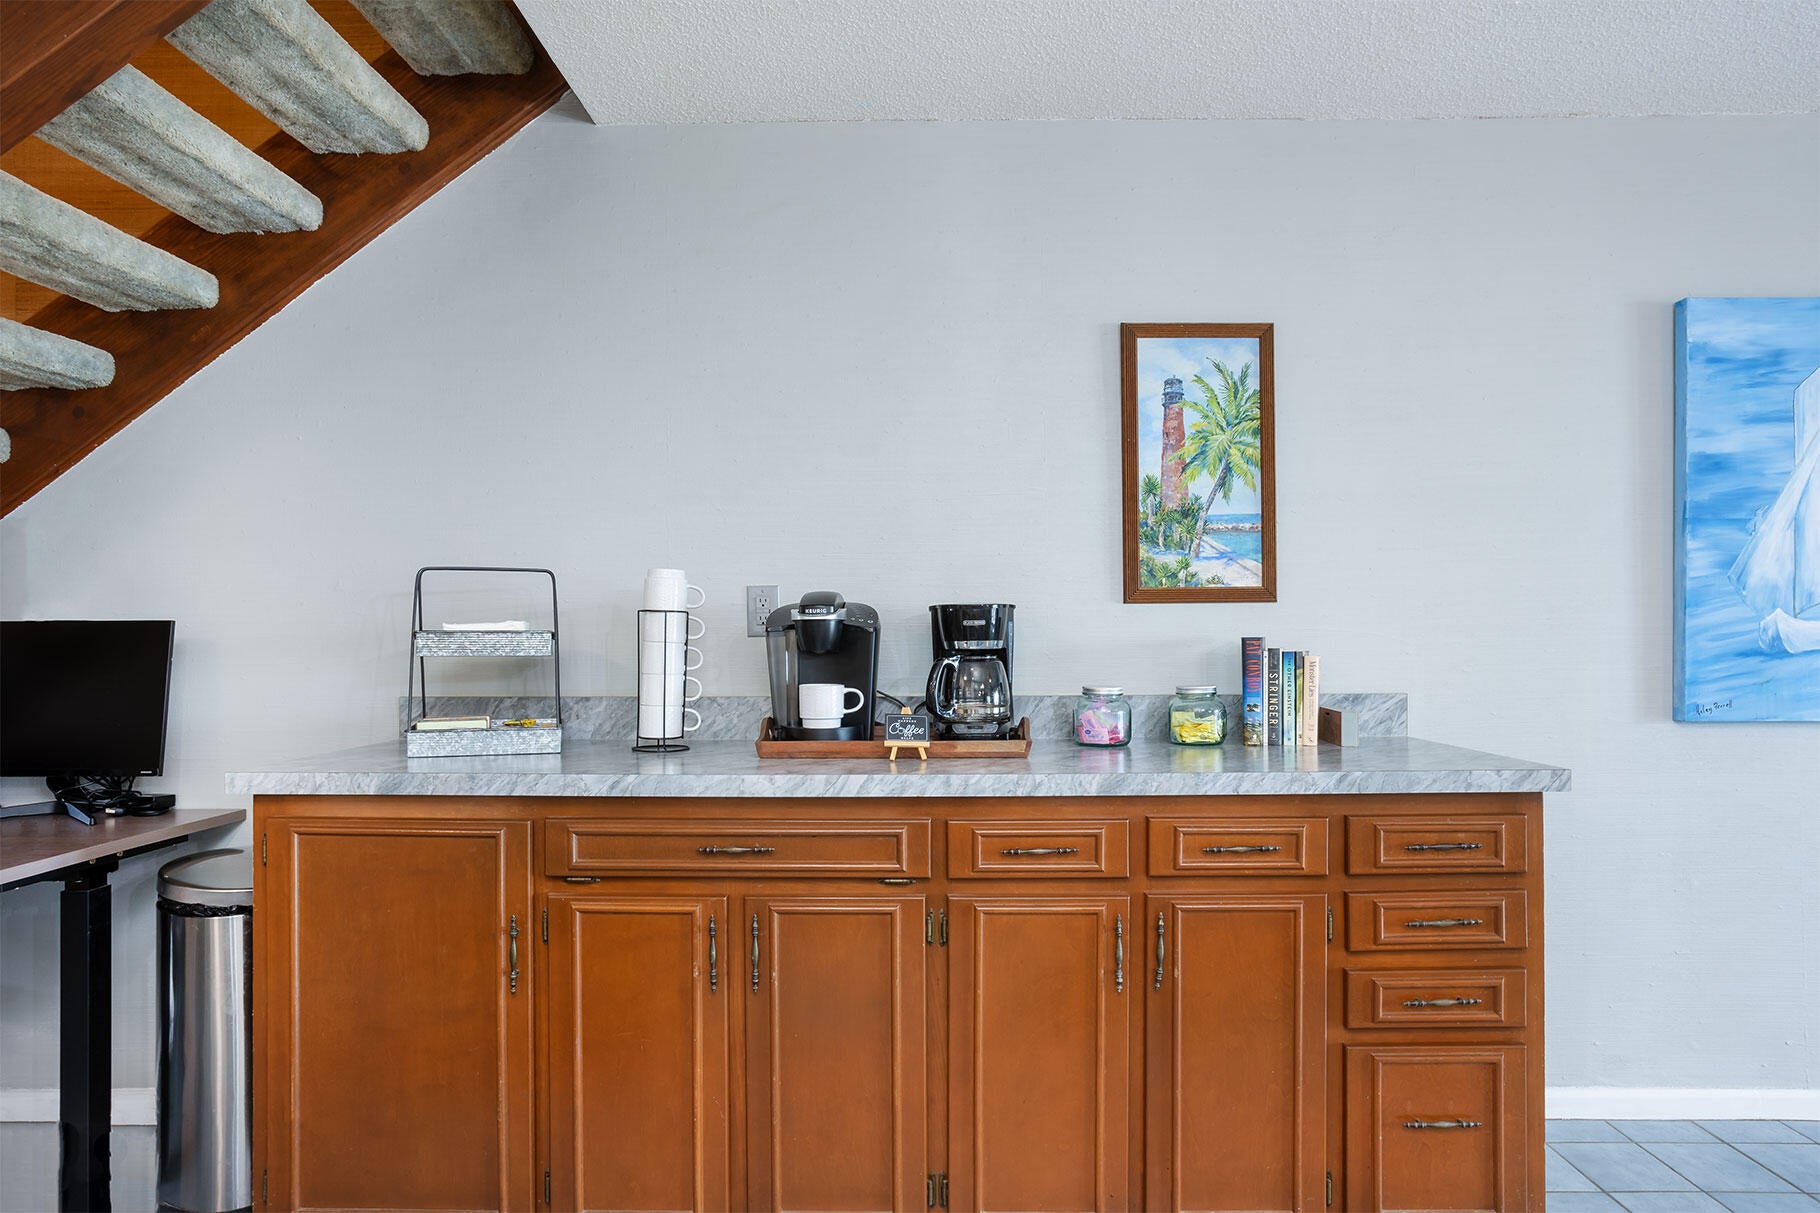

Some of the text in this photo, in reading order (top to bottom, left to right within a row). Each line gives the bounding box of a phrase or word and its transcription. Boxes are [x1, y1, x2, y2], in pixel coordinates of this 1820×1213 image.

[1246, 639, 1261, 693] PAT CONROY
[1269, 672, 1279, 725] STRINGER
[889, 723, 925, 737] Coffee
